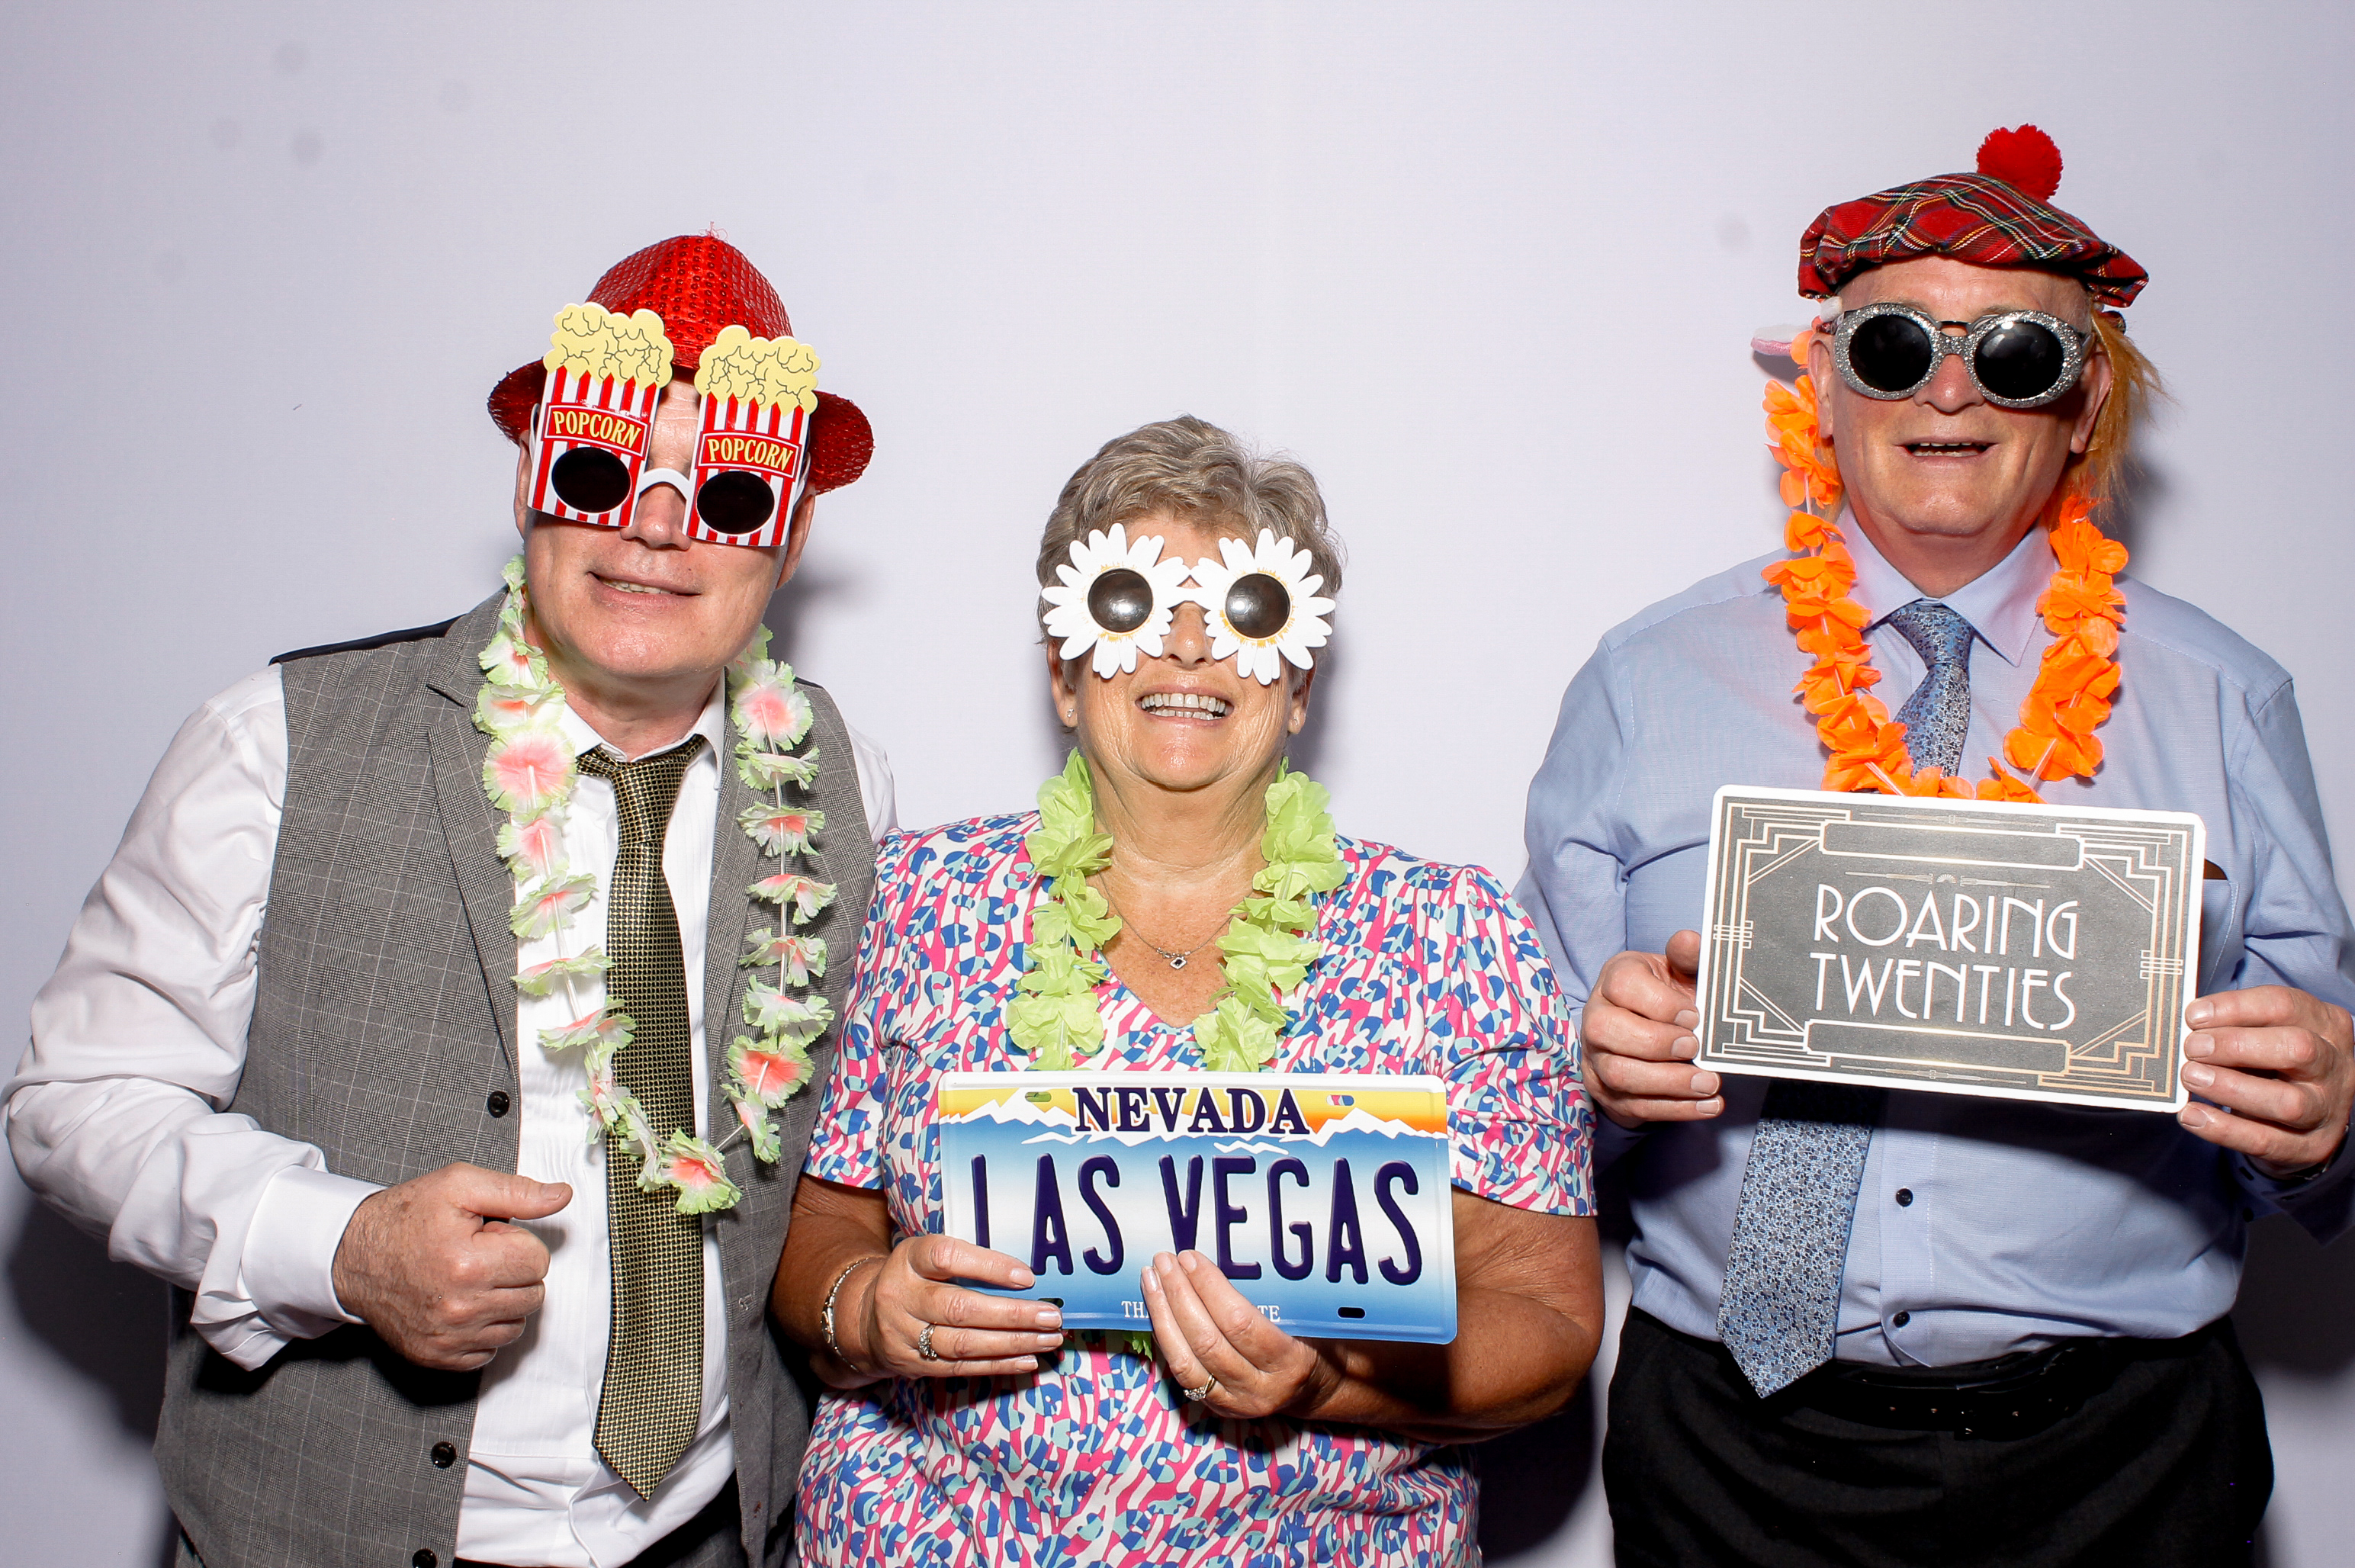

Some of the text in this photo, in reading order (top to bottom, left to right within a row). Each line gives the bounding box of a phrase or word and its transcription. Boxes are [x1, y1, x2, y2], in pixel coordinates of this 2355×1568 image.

[553, 410, 641, 449] POPCORN
[707, 438, 794, 472] POPCORN
[1814, 883, 2078, 960] ROARING
[1810, 952, 2077, 1031] TWENTIES
[1072, 1088, 1309, 1134] NEVADA
[1158, 1154, 1423, 1286] VEGAS
[1121, 1300, 1150, 1319] TH
